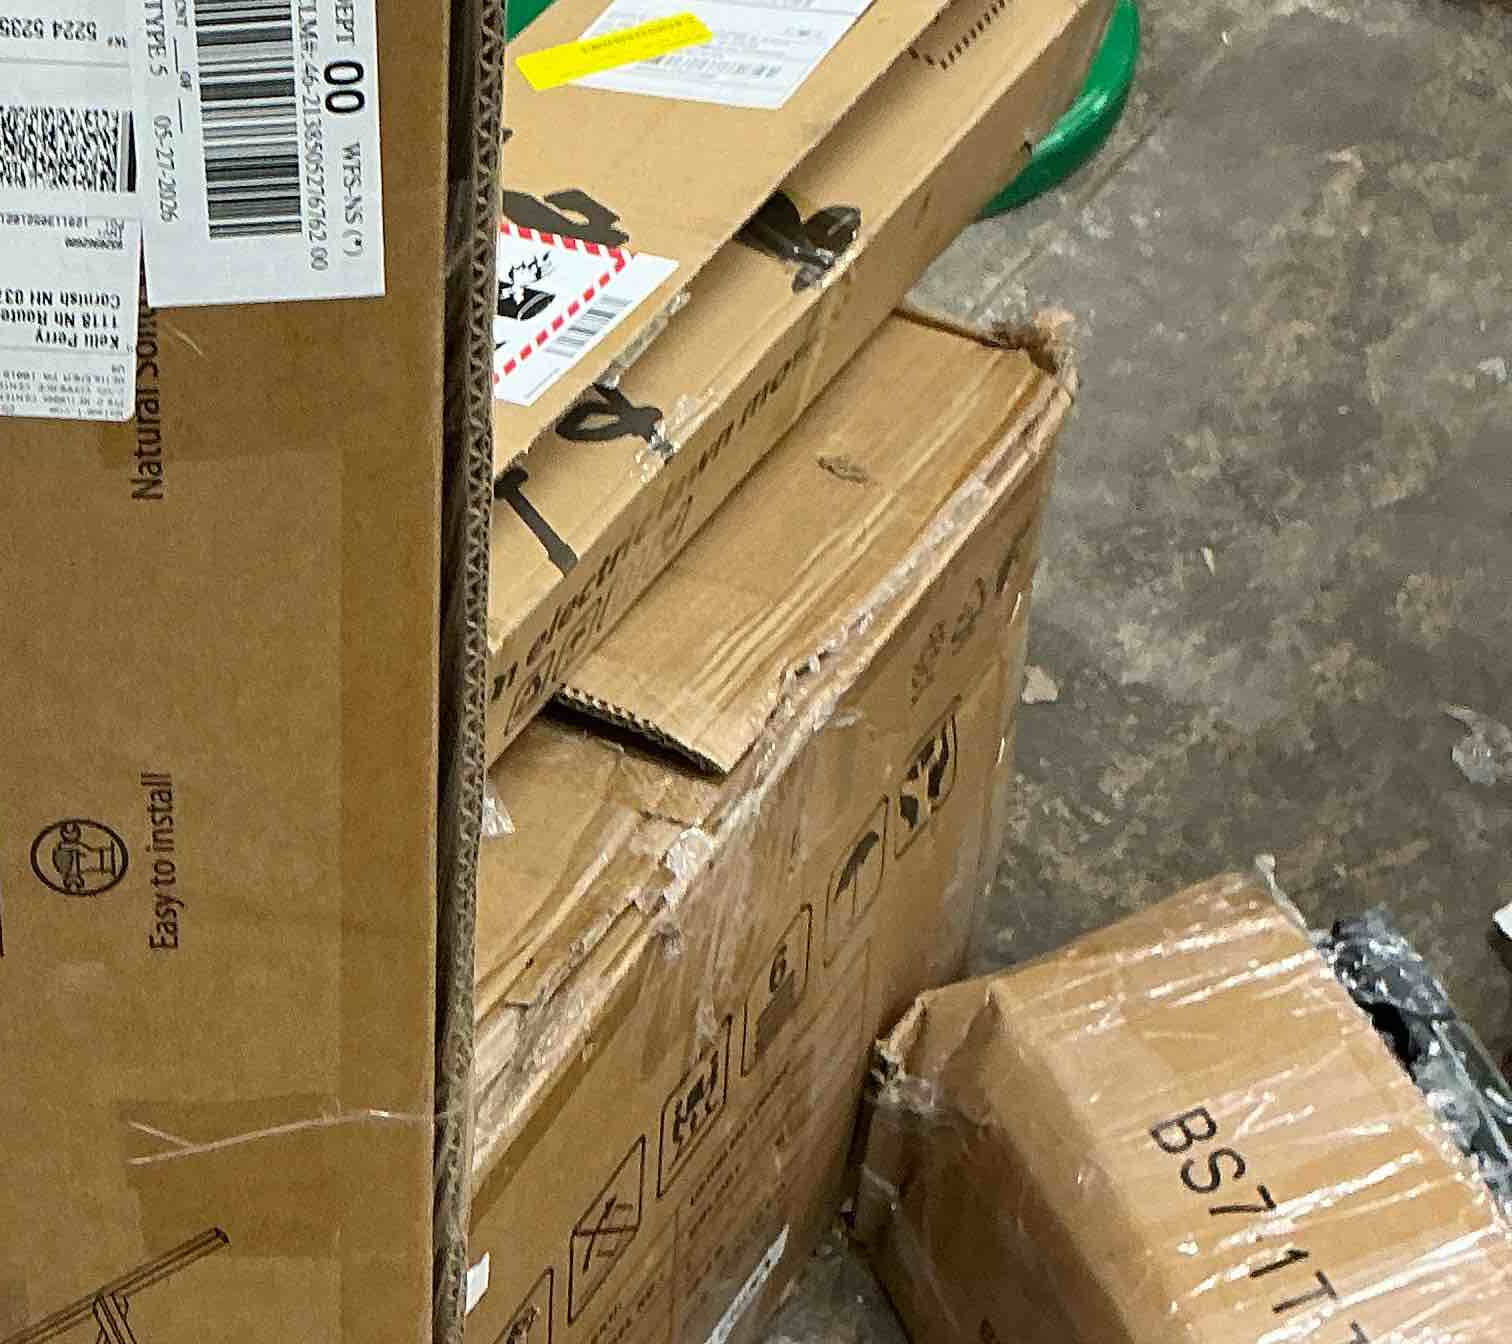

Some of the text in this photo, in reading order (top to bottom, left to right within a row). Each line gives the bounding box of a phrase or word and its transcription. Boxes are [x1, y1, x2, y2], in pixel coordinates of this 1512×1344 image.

[52, 20, 97, 42] 5224
[149, 64, 168, 76] 5
[323, 60, 365, 114] 00
[30, 290, 63, 308] NH
[35, 329, 120, 350] Kelli Perry
[130, 386, 163, 501] Natural
[140, 771, 185, 950] Easy to install
